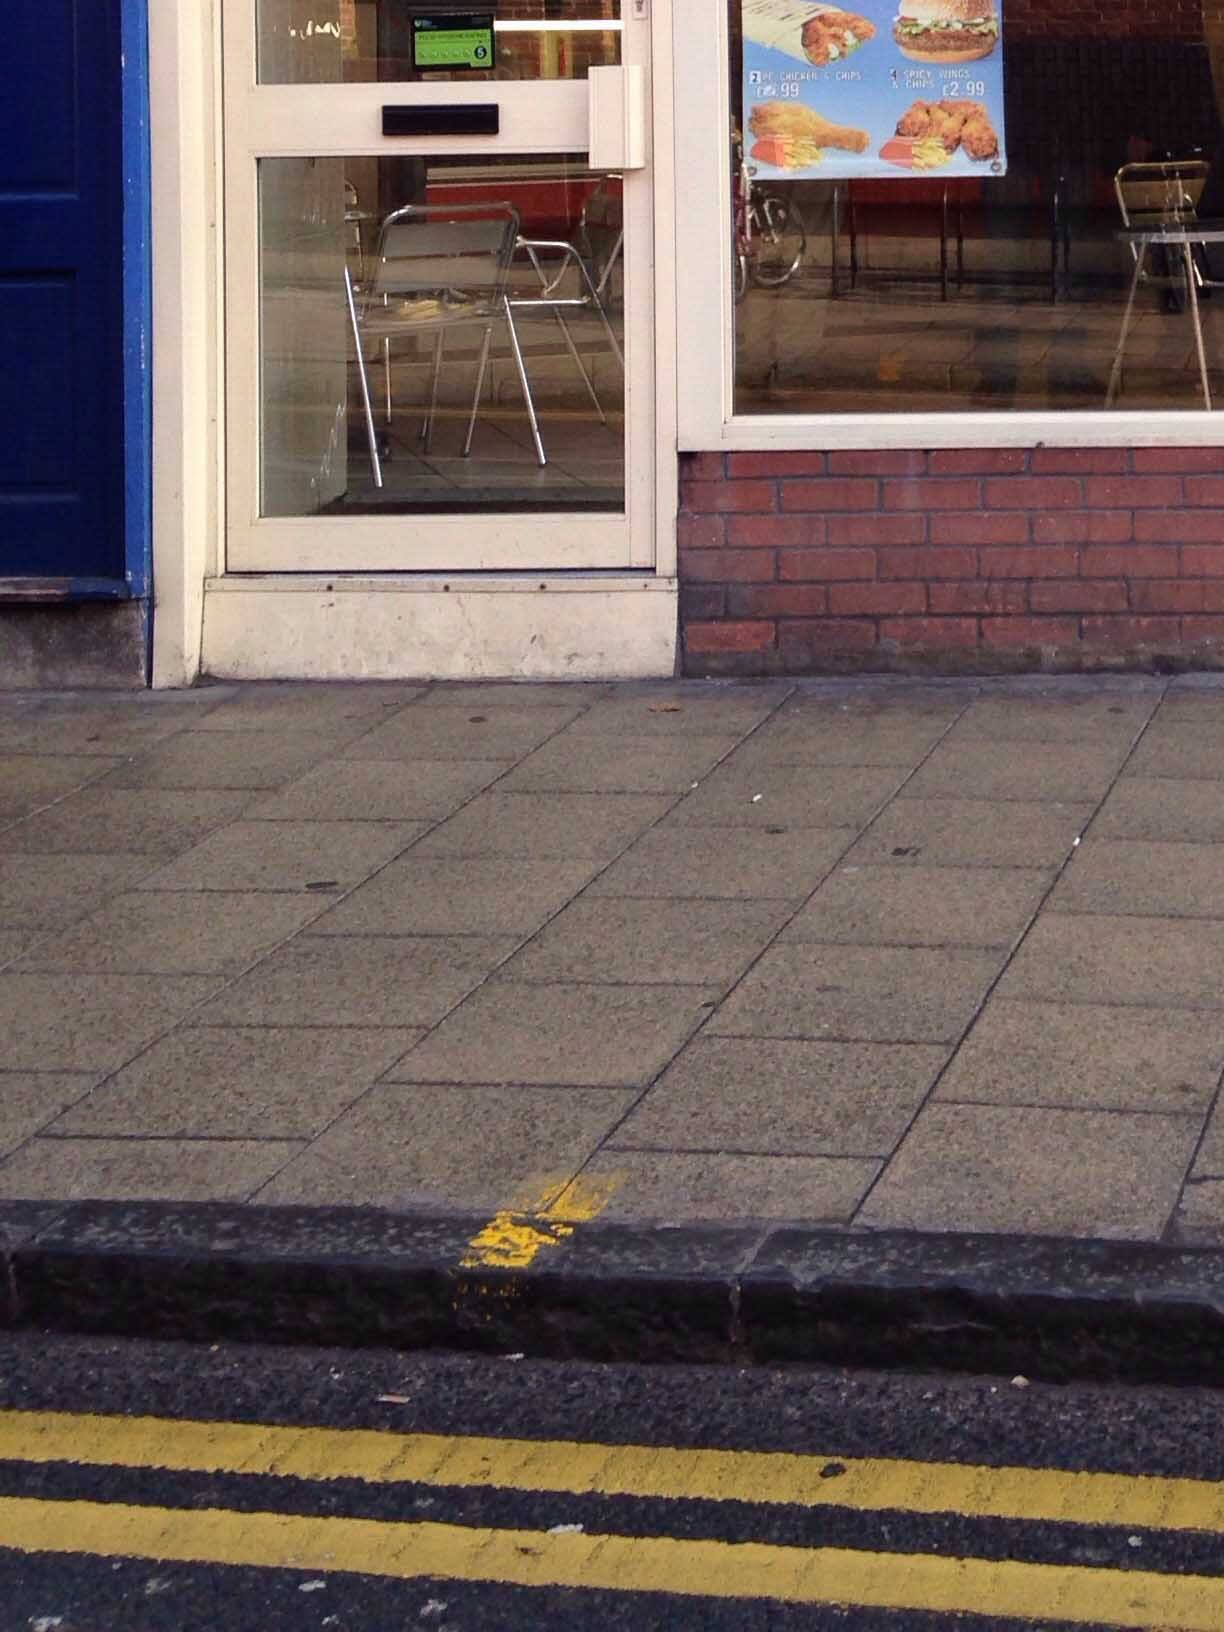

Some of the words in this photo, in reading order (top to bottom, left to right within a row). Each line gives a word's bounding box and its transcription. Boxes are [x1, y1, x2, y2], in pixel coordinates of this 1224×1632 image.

[780, 71, 818, 81] CHICKEN
[835, 71, 862, 81] CHIPS
[902, 69, 932, 80] SPICY
[940, 68, 970, 80] WINGS
[904, 79, 935, 89] CHIPS
[942, 80, 986, 97] £2.99
